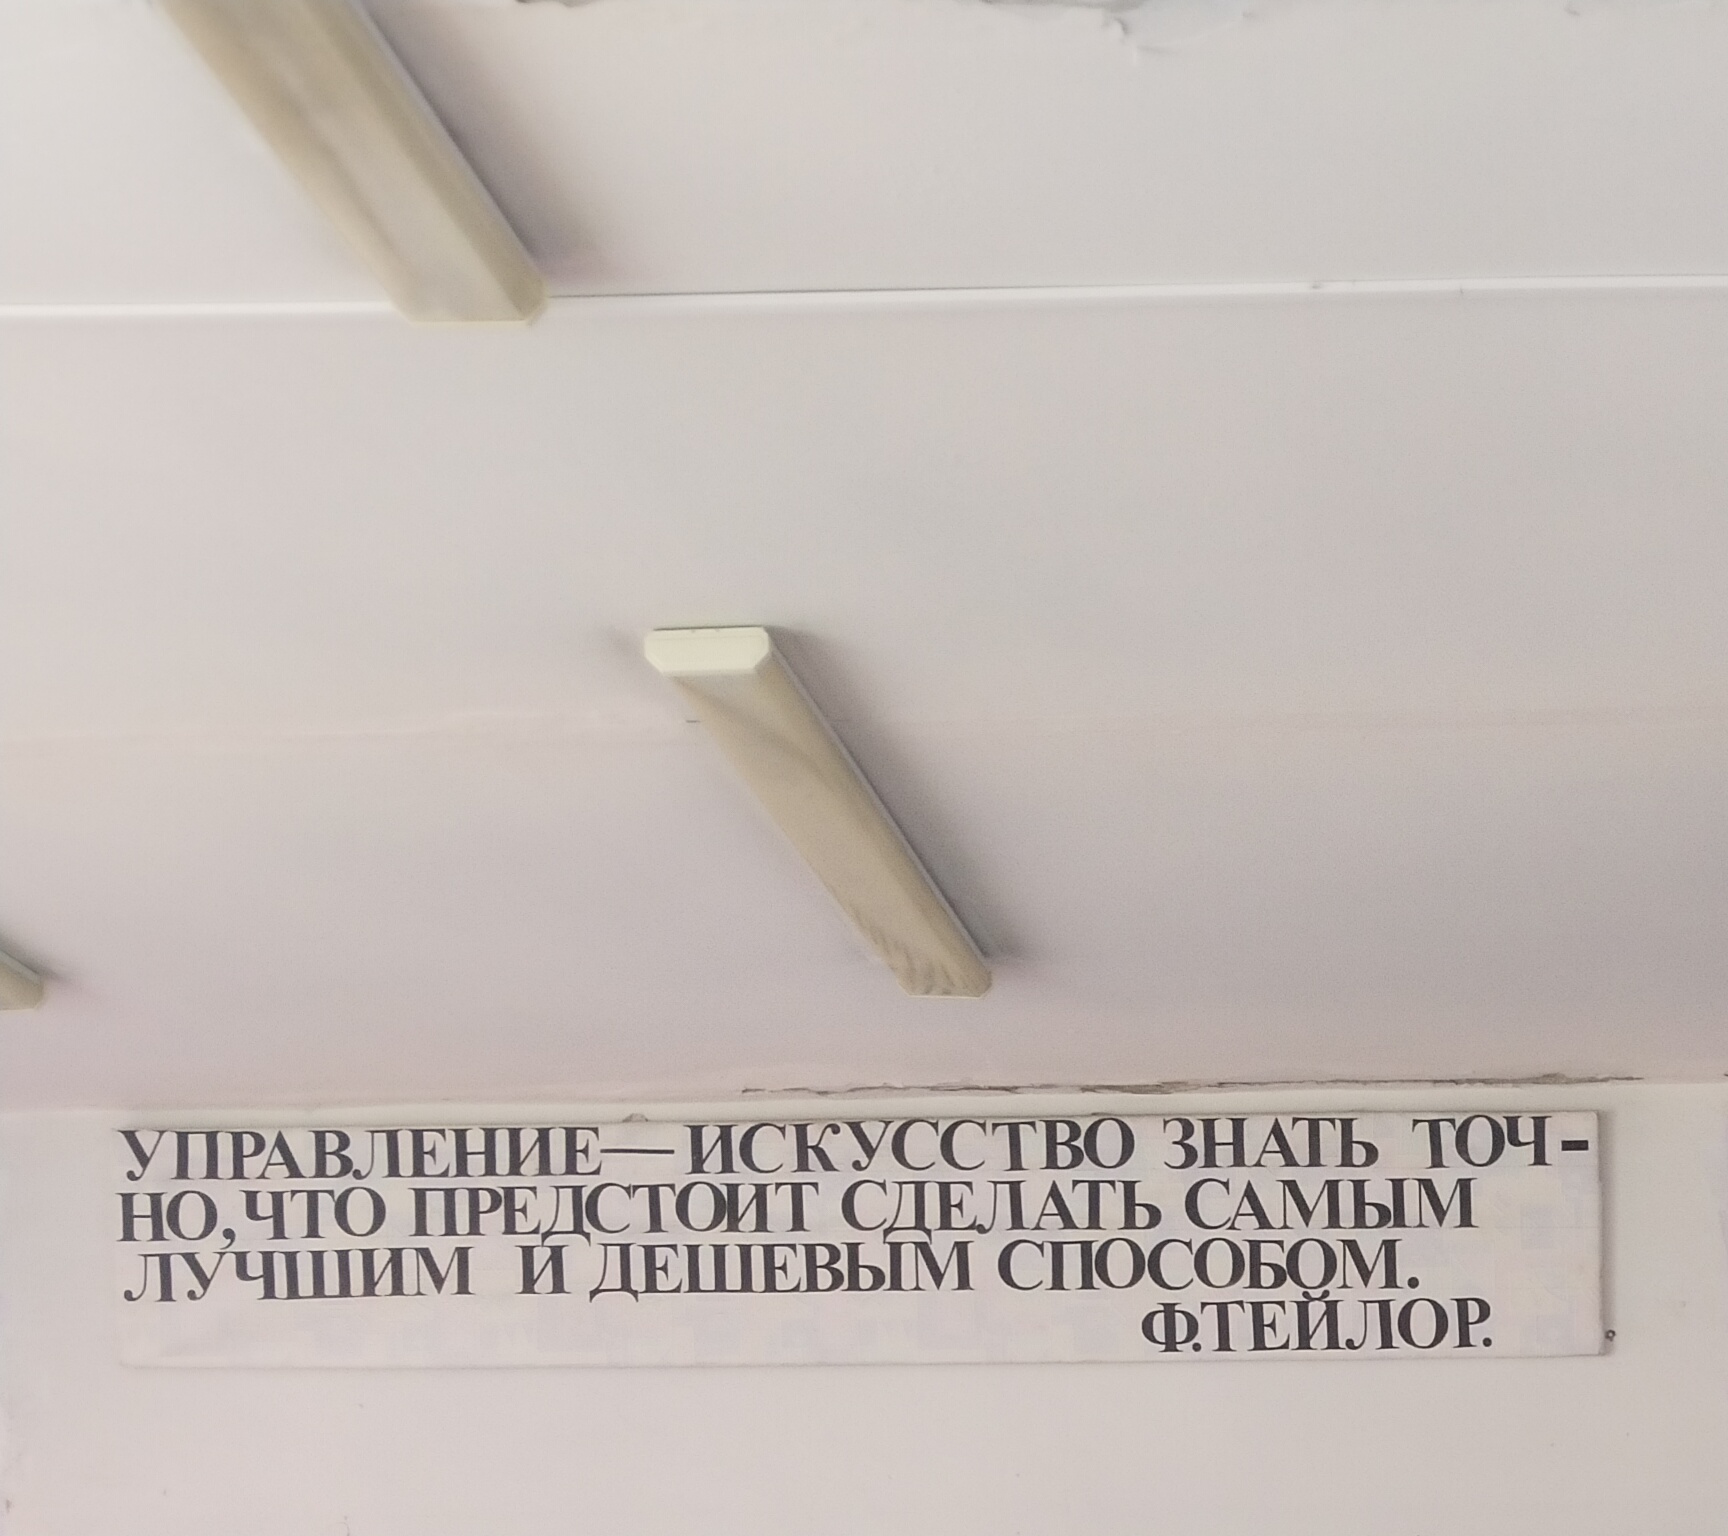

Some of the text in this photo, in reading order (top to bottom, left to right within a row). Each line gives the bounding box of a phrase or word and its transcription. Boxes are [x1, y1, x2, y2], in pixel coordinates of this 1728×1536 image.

[1162, 1117, 1379, 1170] ЗНАТЬ
[1411, 1117, 1589, 1170] ТОЧ-
[409, 1181, 819, 1243] ПРЕДСТОИТ
[842, 1179, 1162, 1241] СДЕЛАТЬ
[1184, 1177, 1479, 1231] САМЫМ
[123, 1238, 1420, 1303] ЛУЧШИМ И ДЕШЕВЫМ СПОСОБОМ.
